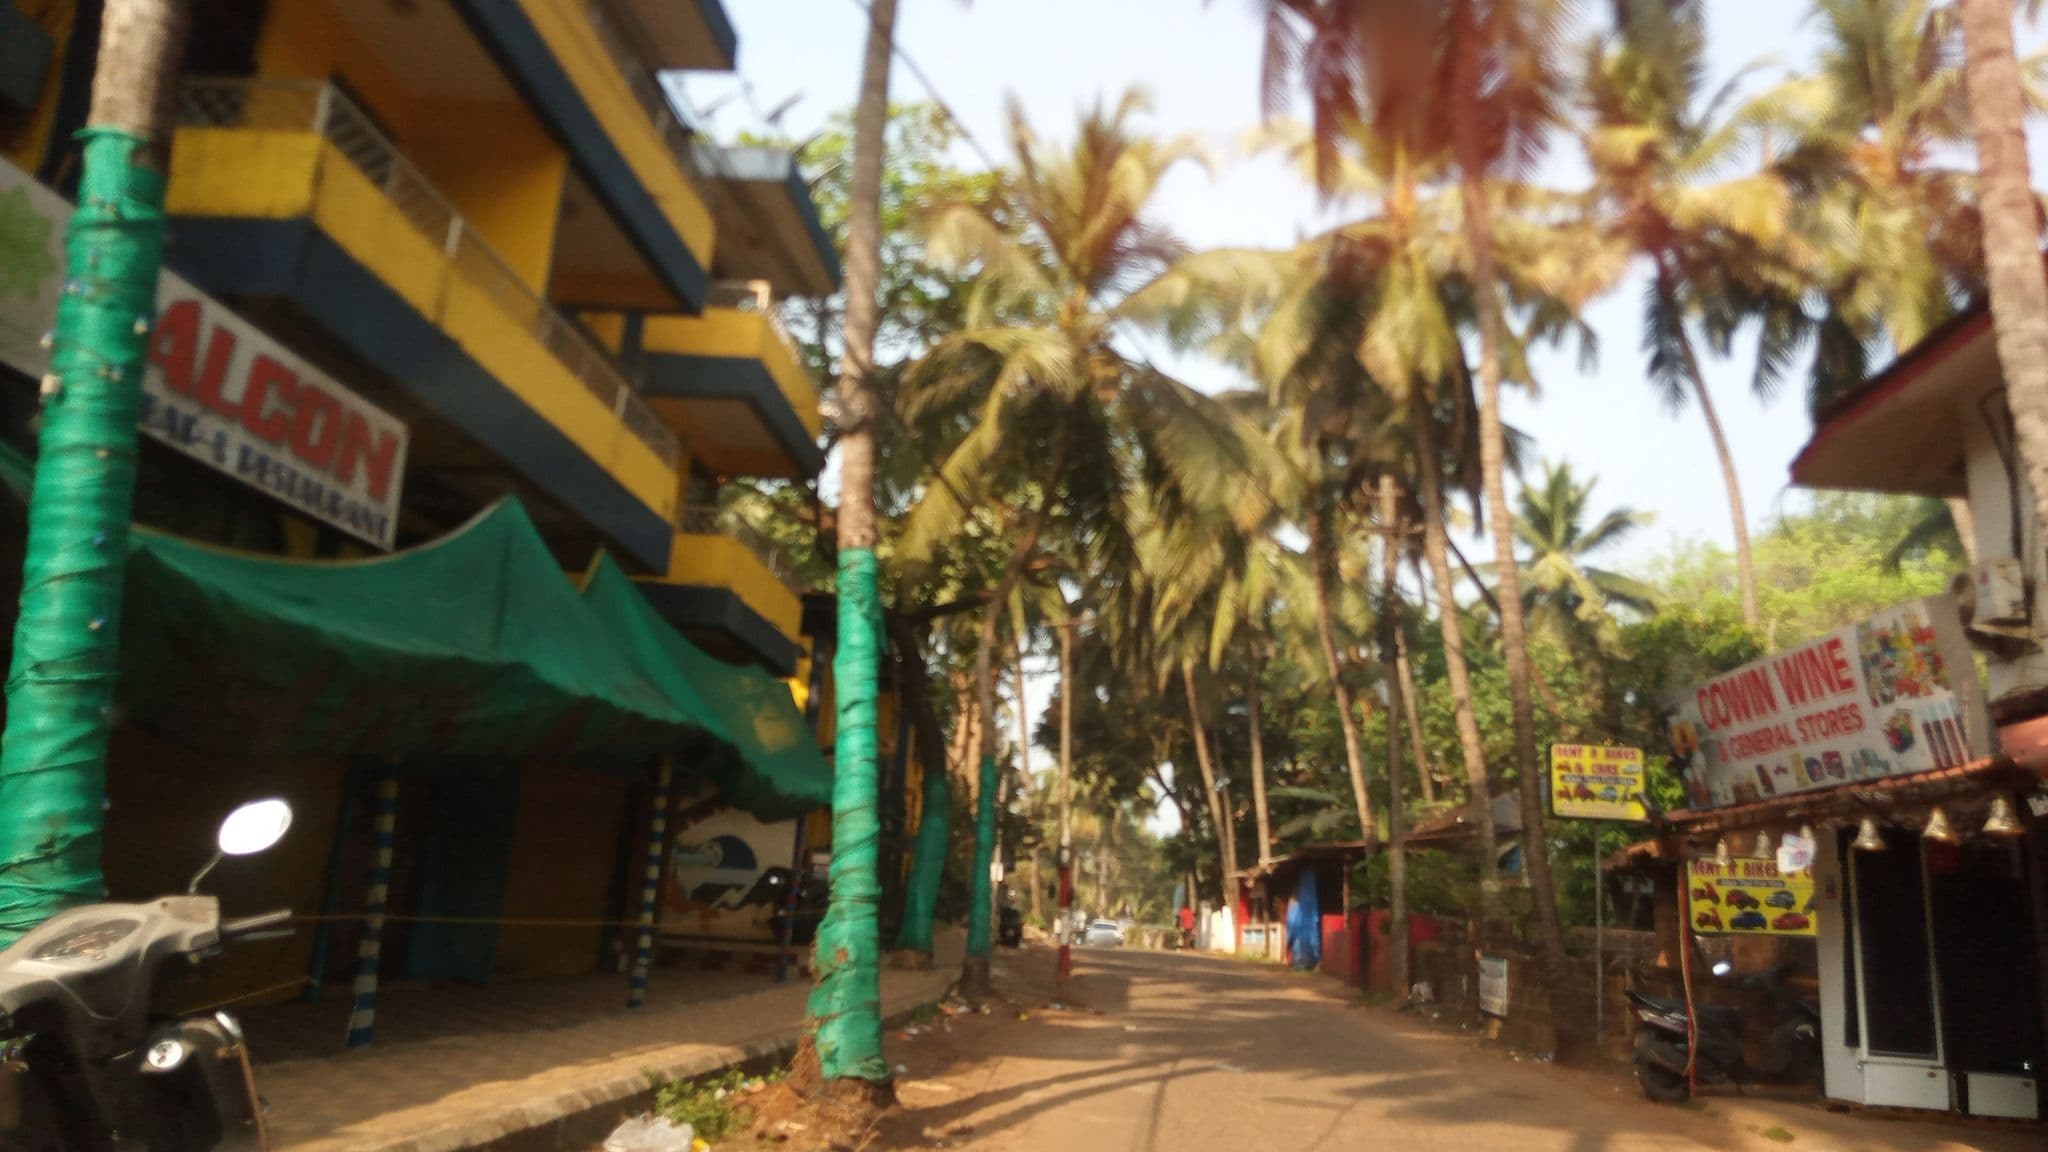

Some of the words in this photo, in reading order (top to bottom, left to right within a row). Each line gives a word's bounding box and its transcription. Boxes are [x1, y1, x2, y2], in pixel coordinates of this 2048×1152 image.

[1773, 637, 1857, 710] WINE
[1729, 721, 1797, 760] GENERAL
[1796, 701, 1866, 743] STORES
[1742, 861, 1779, 877] BIKES
